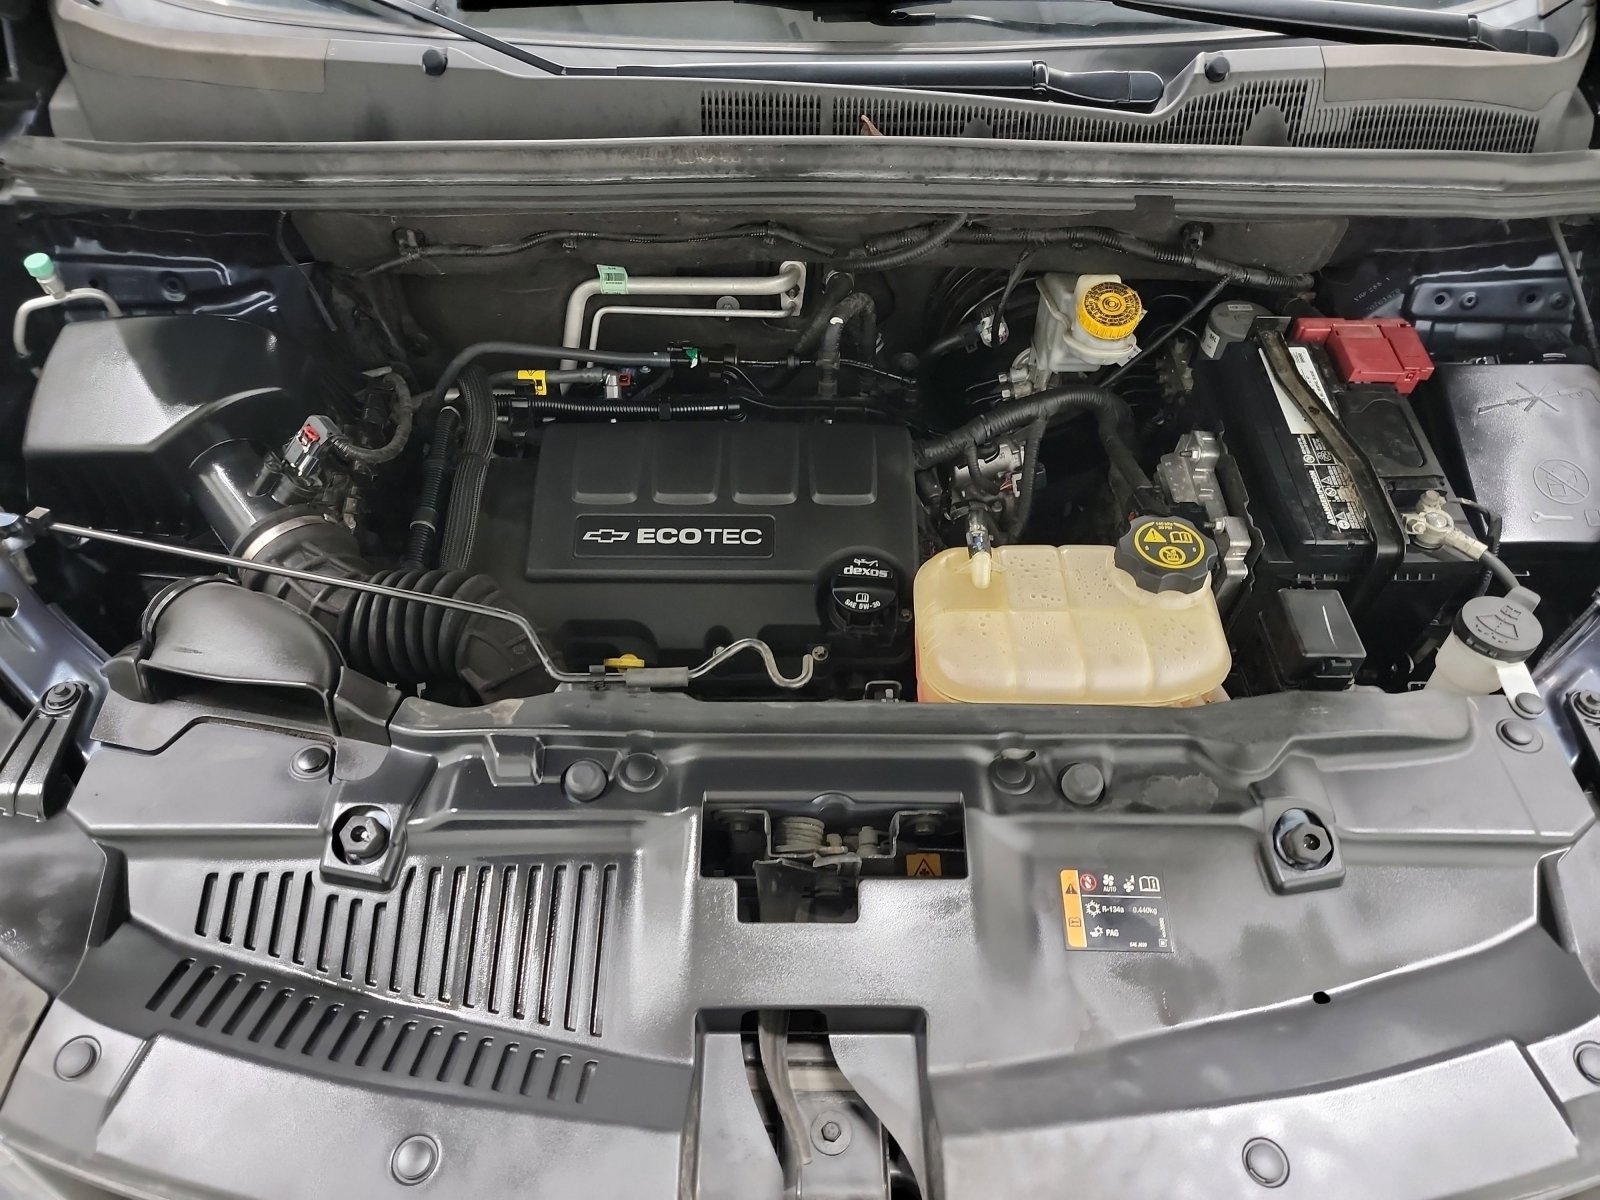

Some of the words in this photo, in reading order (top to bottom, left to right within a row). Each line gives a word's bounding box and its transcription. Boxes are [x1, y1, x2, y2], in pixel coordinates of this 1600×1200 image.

[636, 527, 763, 545] ECOTEC
[843, 565, 889, 578] dexos
[844, 598, 857, 609] SAE
[1101, 905, 1125, 914] R-134a
[1132, 906, 1158, 915] 0.440kg
[1105, 929, 1120, 937] PAG
